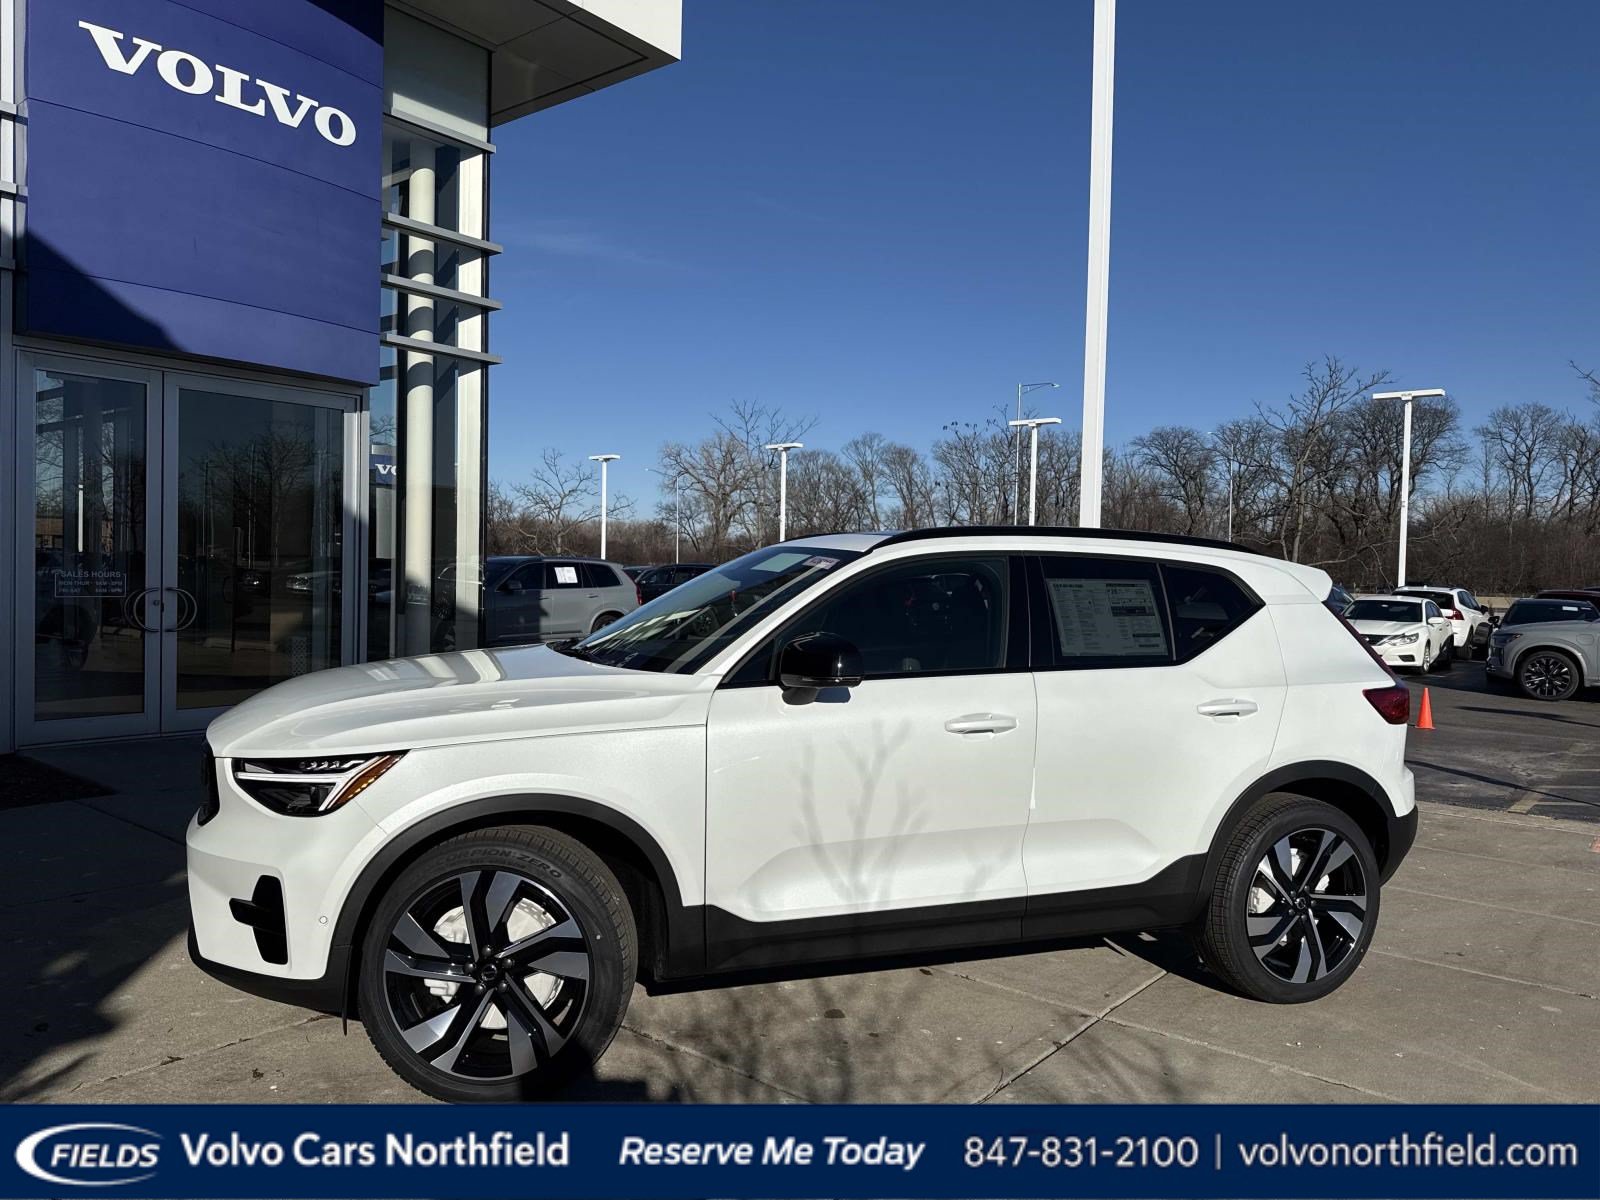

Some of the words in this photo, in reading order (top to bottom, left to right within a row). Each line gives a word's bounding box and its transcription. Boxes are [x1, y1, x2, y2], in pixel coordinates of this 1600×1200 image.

[78, 20, 357, 147] VOLVO
[60, 570, 89, 578] SALES
[91, 570, 121, 578] HOURS
[434, 848, 512, 864] CORPION
[516, 853, 562, 878] ZERO
